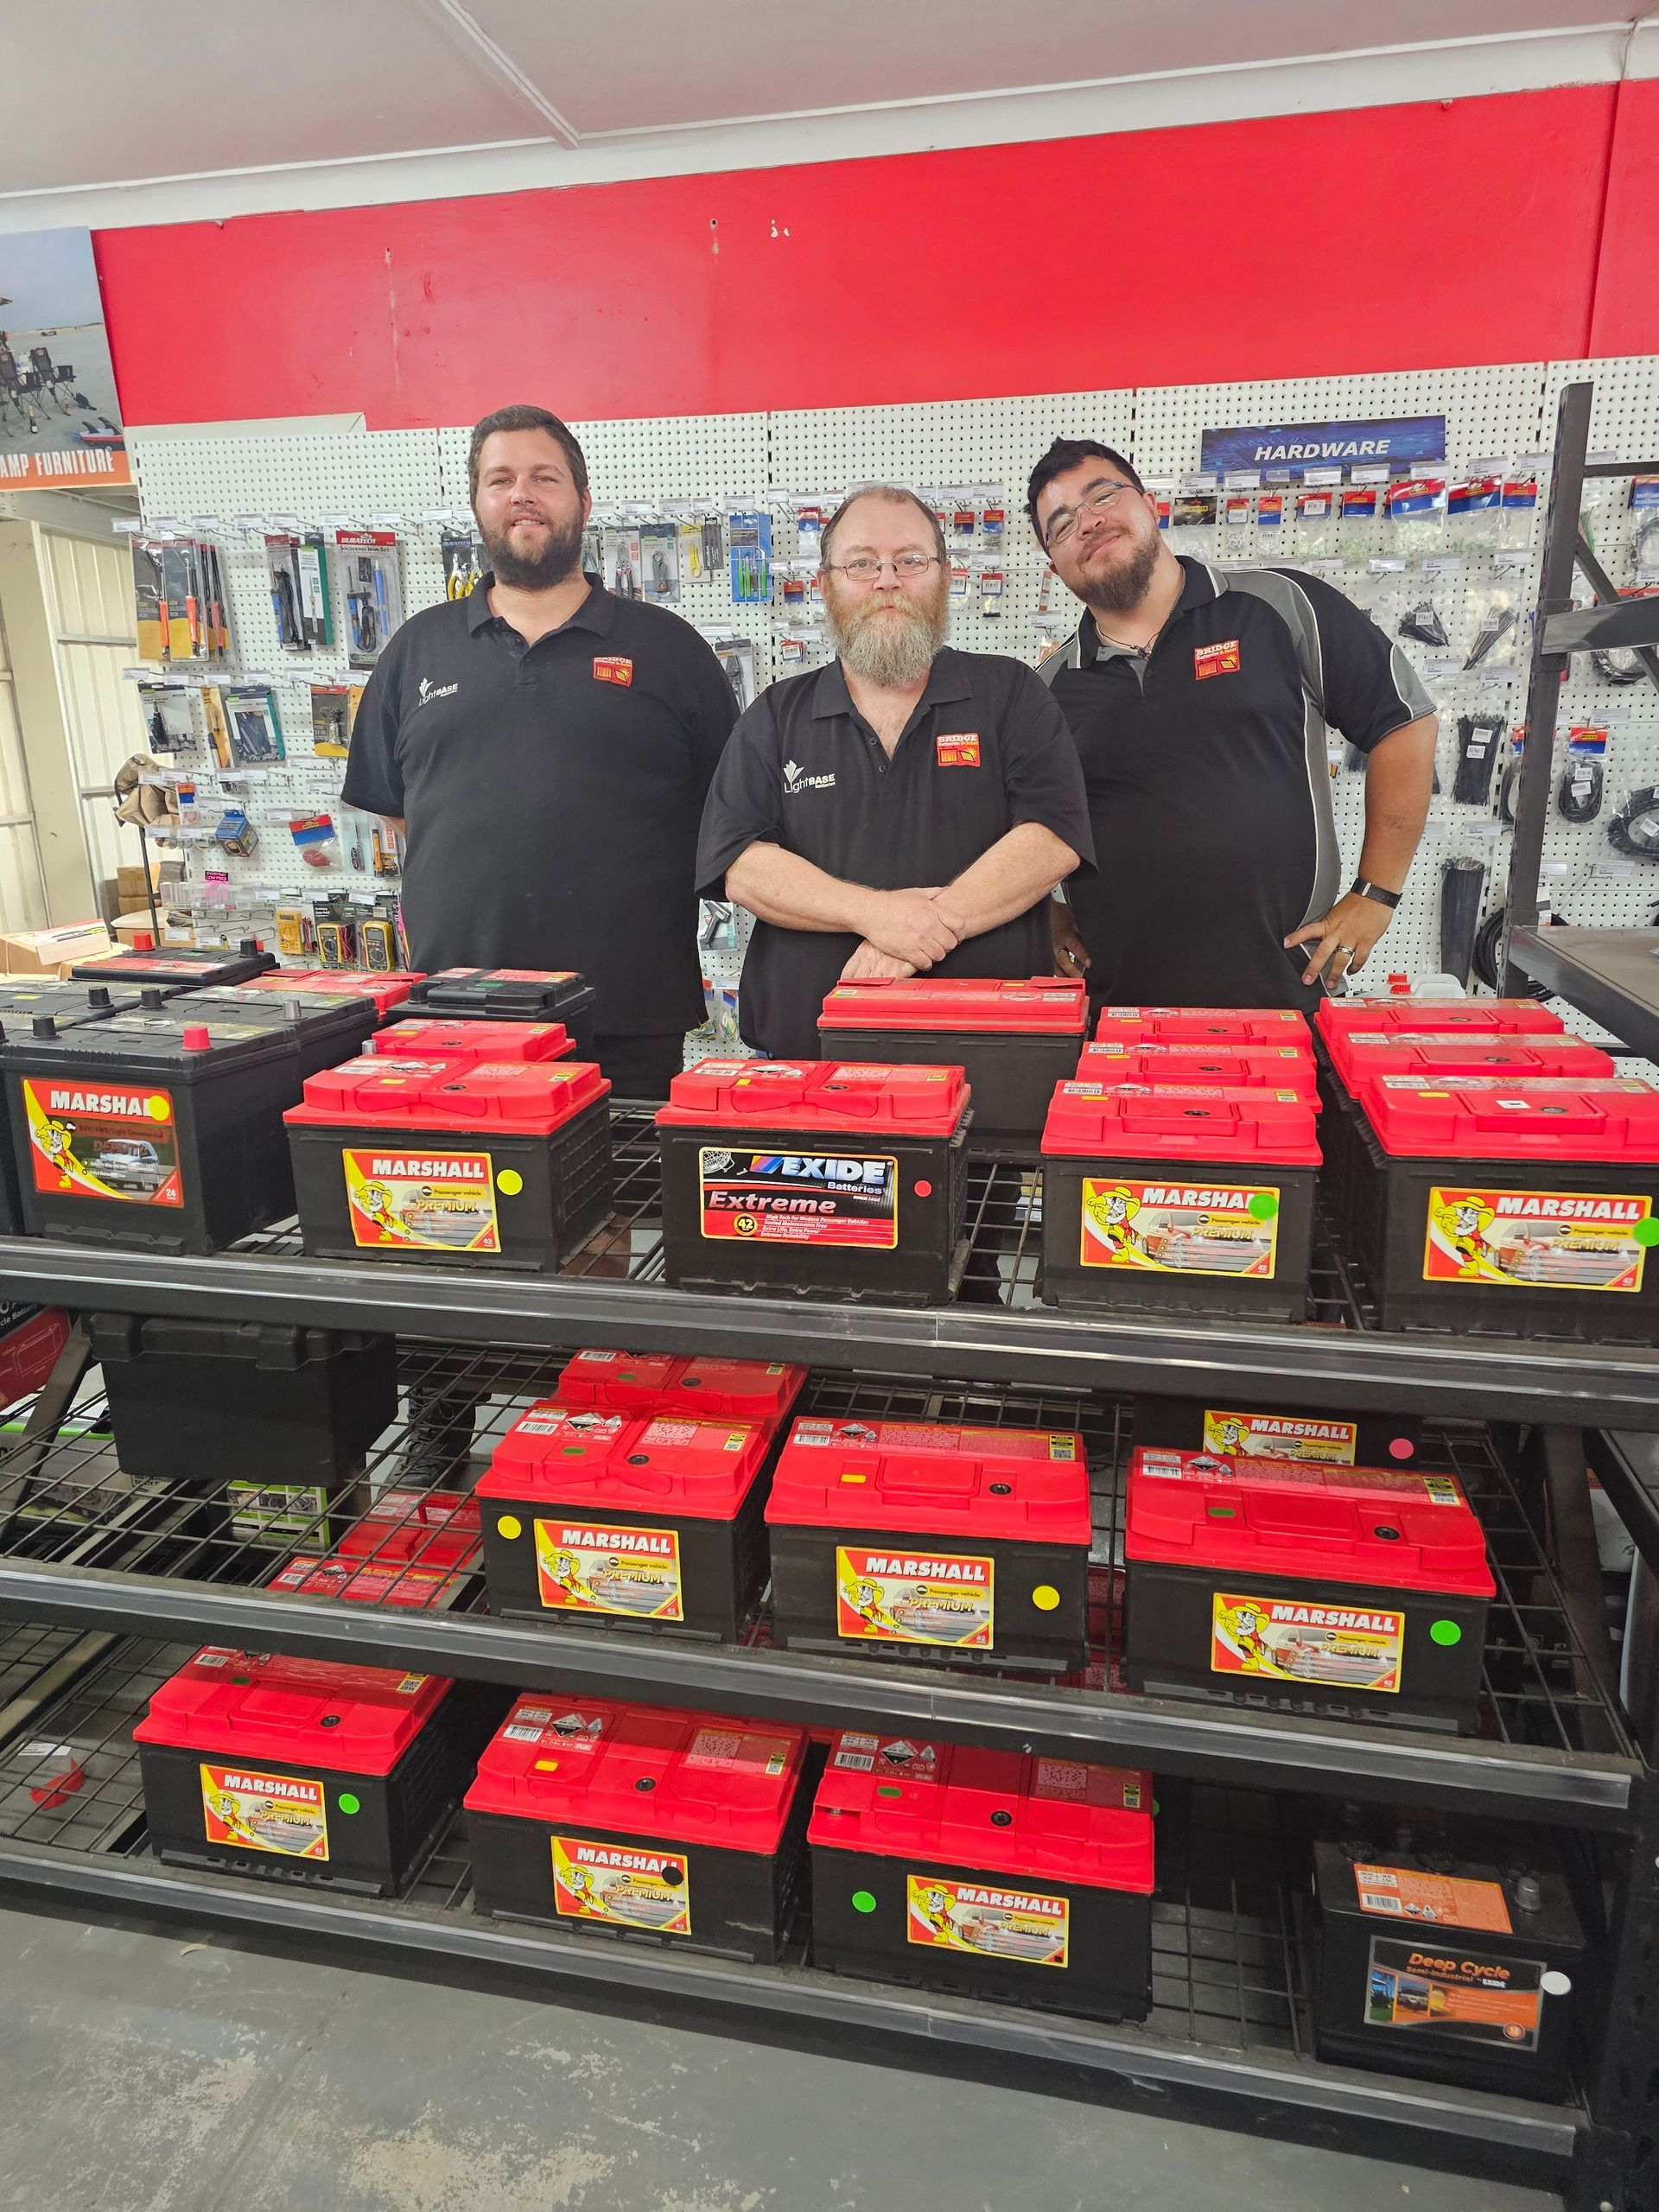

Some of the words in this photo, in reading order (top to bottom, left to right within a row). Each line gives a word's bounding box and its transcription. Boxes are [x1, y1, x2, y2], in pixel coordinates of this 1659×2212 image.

[1254, 439, 1391, 461] HARDWARE
[35, 448, 115, 476] FURNITURE
[1195, 640, 1237, 657] BRIDGE
[938, 734, 978, 743] BRIDGE
[783, 772, 836, 794] LightBASE
[50, 1090, 155, 1118] MARSHAL
[372, 1159, 485, 1179] MARSHALL
[781, 1156, 886, 1185] EXIDE
[166, 1188, 176, 1198] 24
[827, 1181, 883, 1195] Batteries
[417, 1199, 476, 1212] PREMIUM
[709, 1190, 837, 1215] Extreme
[1496, 1197, 1640, 1220] MARSHALL
[736, 1217, 754, 1230] 42
[1190, 1226, 1253, 1240] PREMIUM
[1549, 1238, 1621, 1251] PREMIUM
[1250, 1419, 1350, 1440] MARSHALL
[1288, 1449, 1337, 1460] PREMIUM
[563, 1529, 671, 1554] MARSHALL
[603, 1569, 662, 1584] PREMIUM
[866, 1557, 986, 1581] MARSHALL
[929, 1588, 959, 1597] Passenger
[909, 1598, 974, 1612] PREMIUM
[1271, 1605, 1395, 1632] MARSHALL
[1319, 1643, 1380, 1657] PREMIUM
[225, 1774, 318, 1801] MARSHALL
[259, 1811, 311, 1826] PREMIUM
[616, 1885, 671, 1901] PREMIUM
[957, 1887, 1062, 1916] MARSHALL
[998, 1922, 1050, 1936] PREMIUM
[1408, 1952, 1457, 1972] Deep
[1460, 1961, 1511, 1980] Cycle
